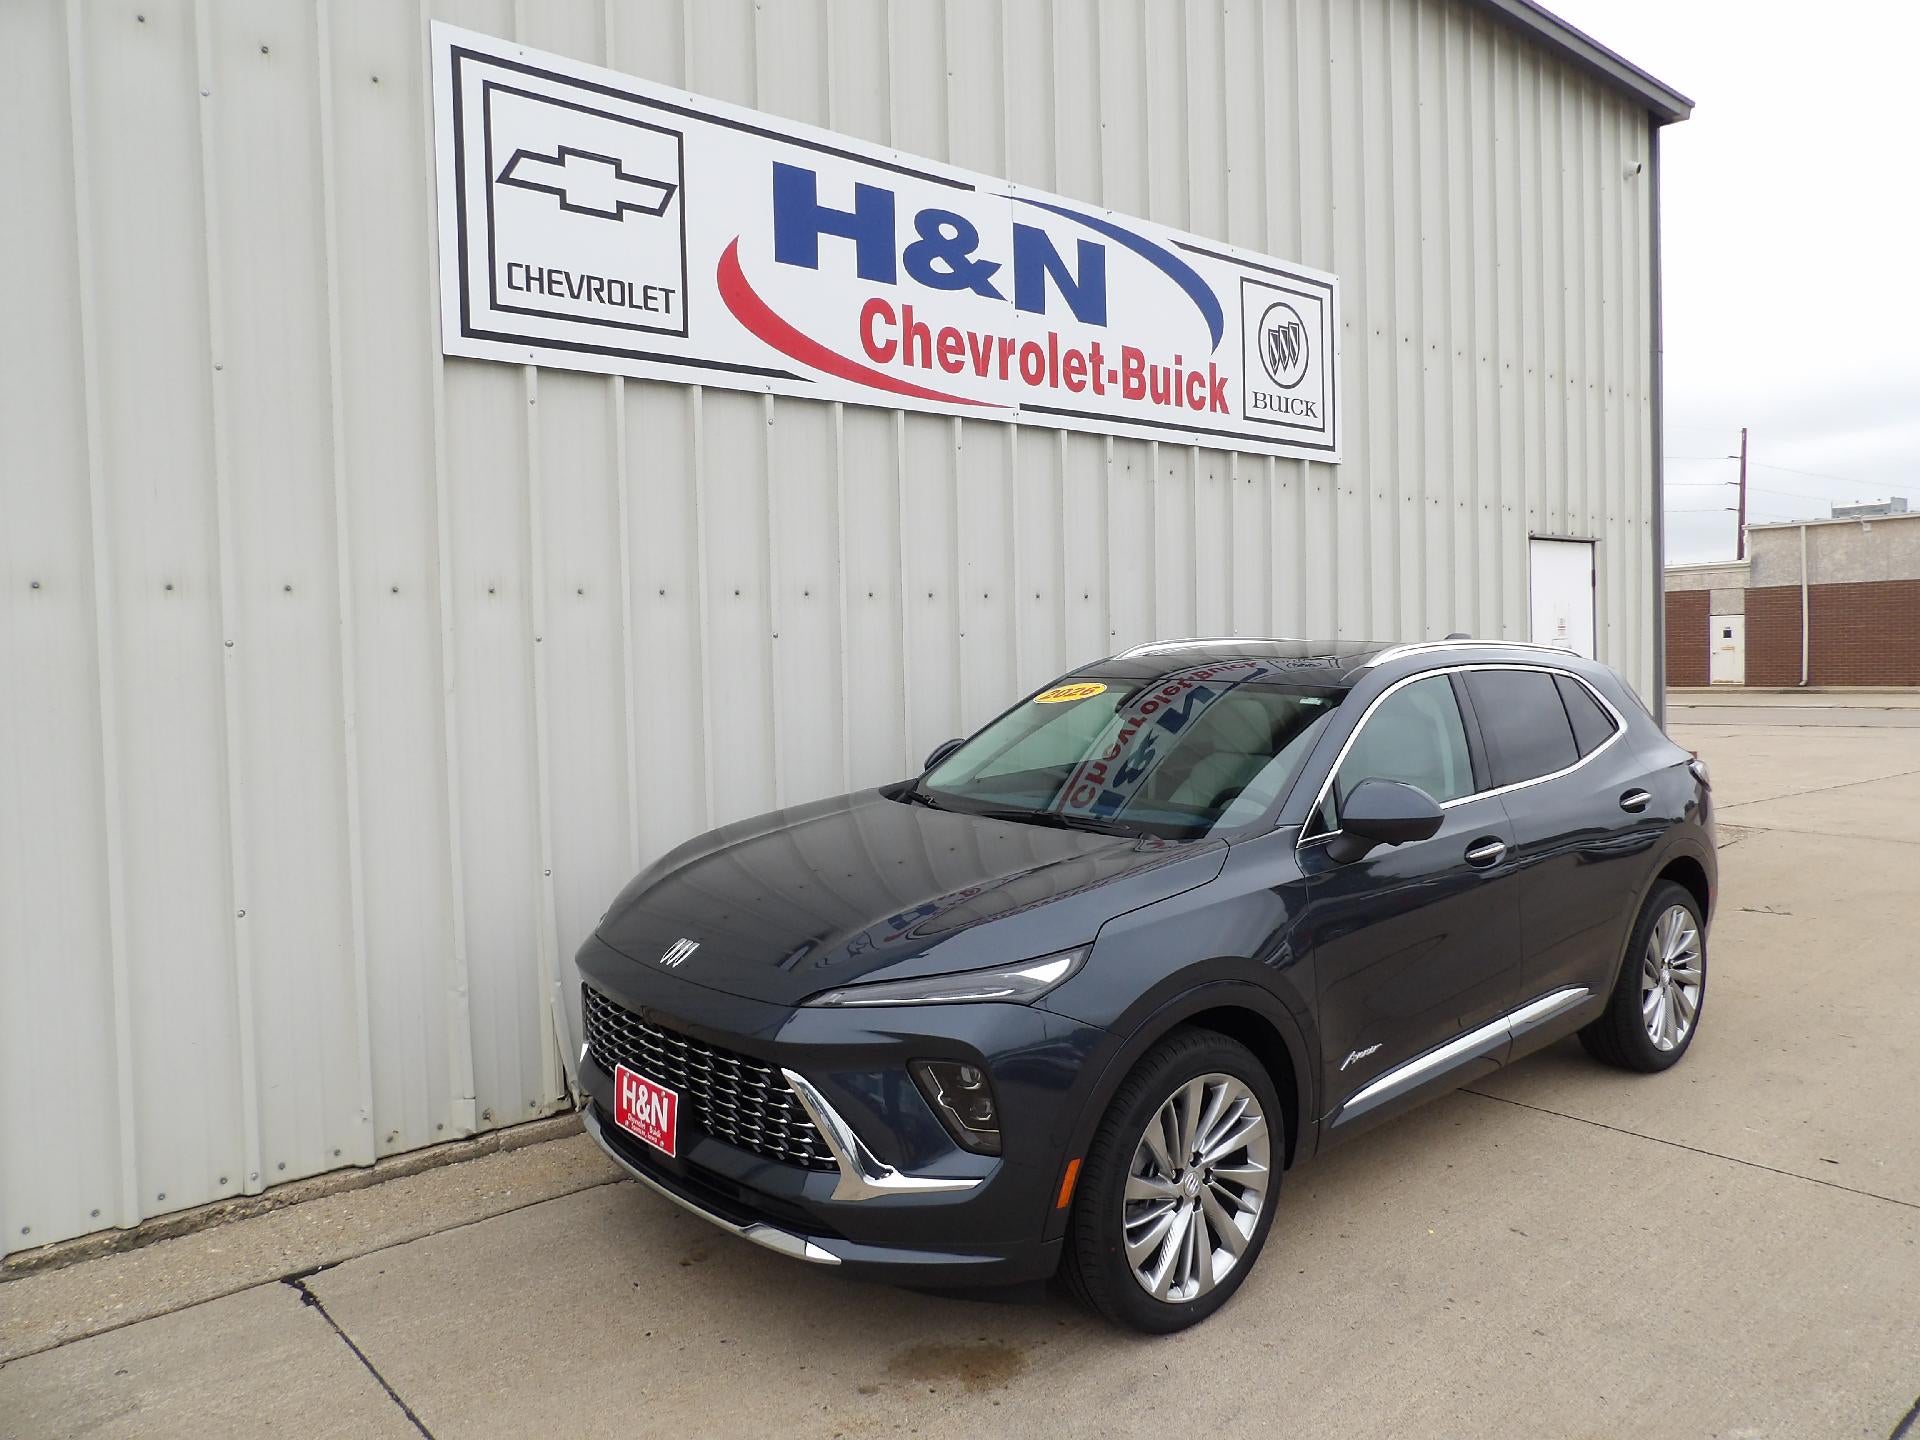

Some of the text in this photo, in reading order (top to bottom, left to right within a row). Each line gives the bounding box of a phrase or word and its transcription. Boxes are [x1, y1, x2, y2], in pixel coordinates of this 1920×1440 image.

[772, 161, 1107, 328] H&N
[507, 262, 676, 315] CHEVROLET
[859, 298, 1231, 415] Chevrolet-Buick
[1252, 390, 1318, 418] BUICK
[1038, 685, 1101, 701] 2026
[623, 1075, 668, 1132] H&N
